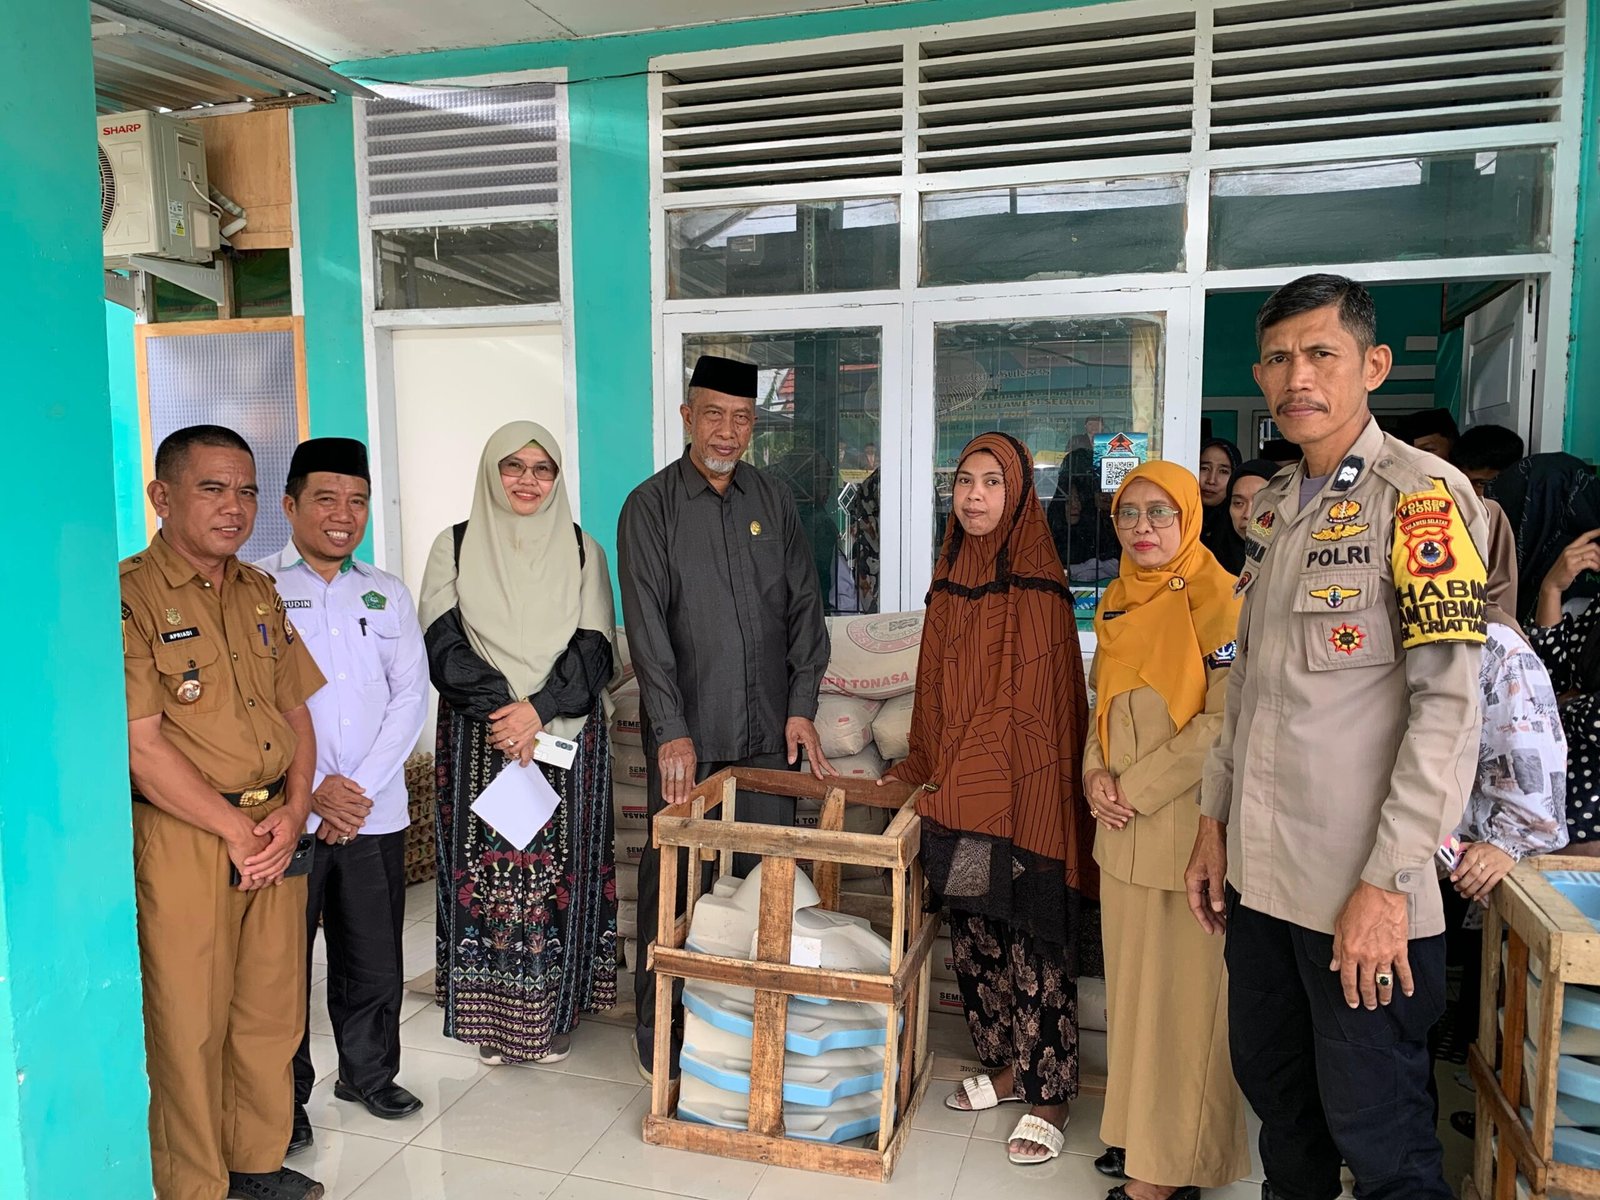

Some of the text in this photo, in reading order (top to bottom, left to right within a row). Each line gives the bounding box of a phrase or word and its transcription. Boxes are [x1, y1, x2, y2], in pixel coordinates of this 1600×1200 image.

[103, 123, 141, 136] SHARP
[1044, 398, 1095, 407] SELATAN
[1401, 500, 1446, 515] POLRES
[1306, 545, 1371, 568] POLRI
[169, 630, 193, 640] APRIADI
[850, 671, 910, 689] TONASA
